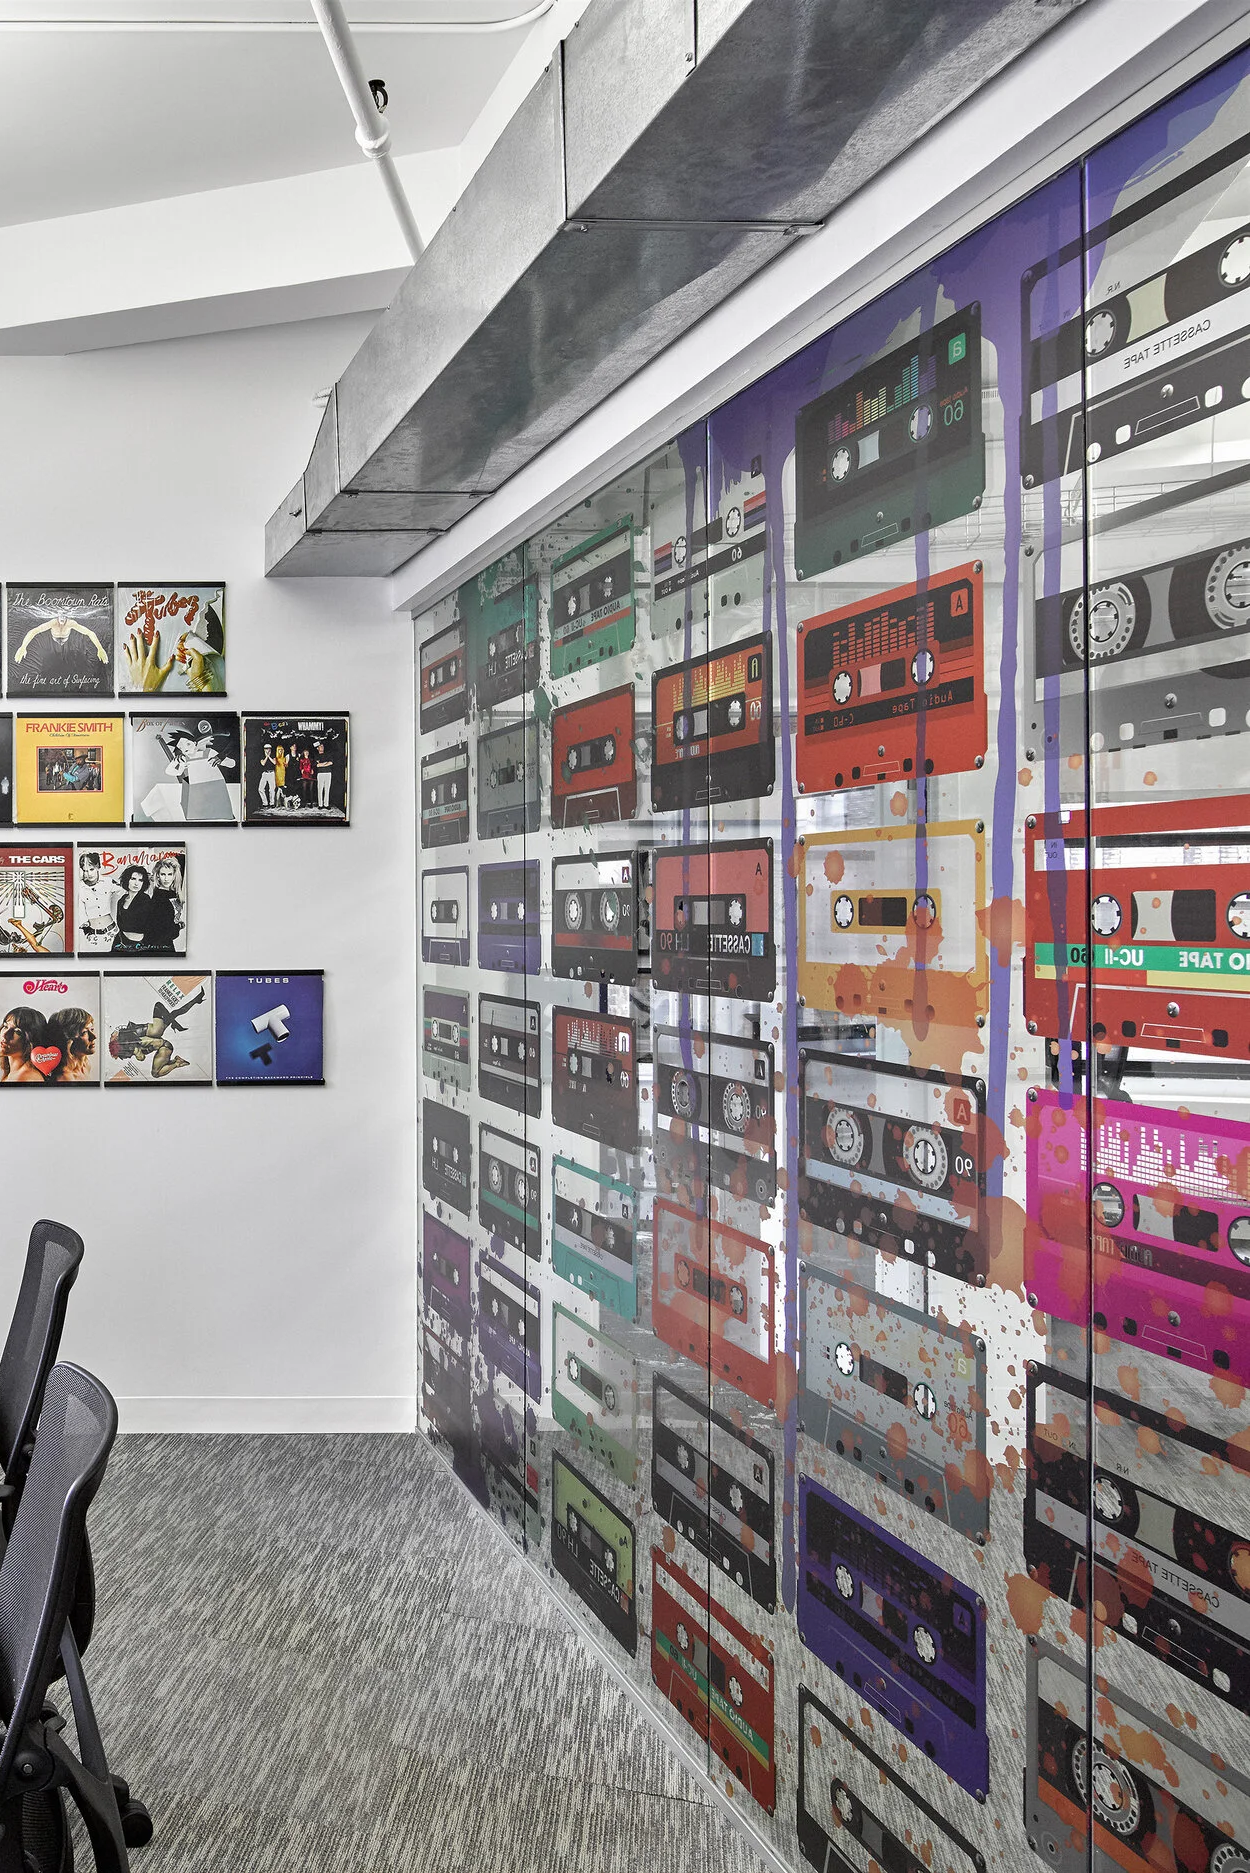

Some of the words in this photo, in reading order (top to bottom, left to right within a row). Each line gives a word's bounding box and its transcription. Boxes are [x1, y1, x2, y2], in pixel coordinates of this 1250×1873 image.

[955, 594, 964, 612] A
[25, 722, 77, 733] FRANKIE
[77, 722, 113, 732] SMITH
[8, 855, 31, 864] THE
[32, 855, 66, 864] CARS
[755, 862, 763, 876] A
[23, 979, 69, 995] Heart
[957, 1103, 967, 1121] A
